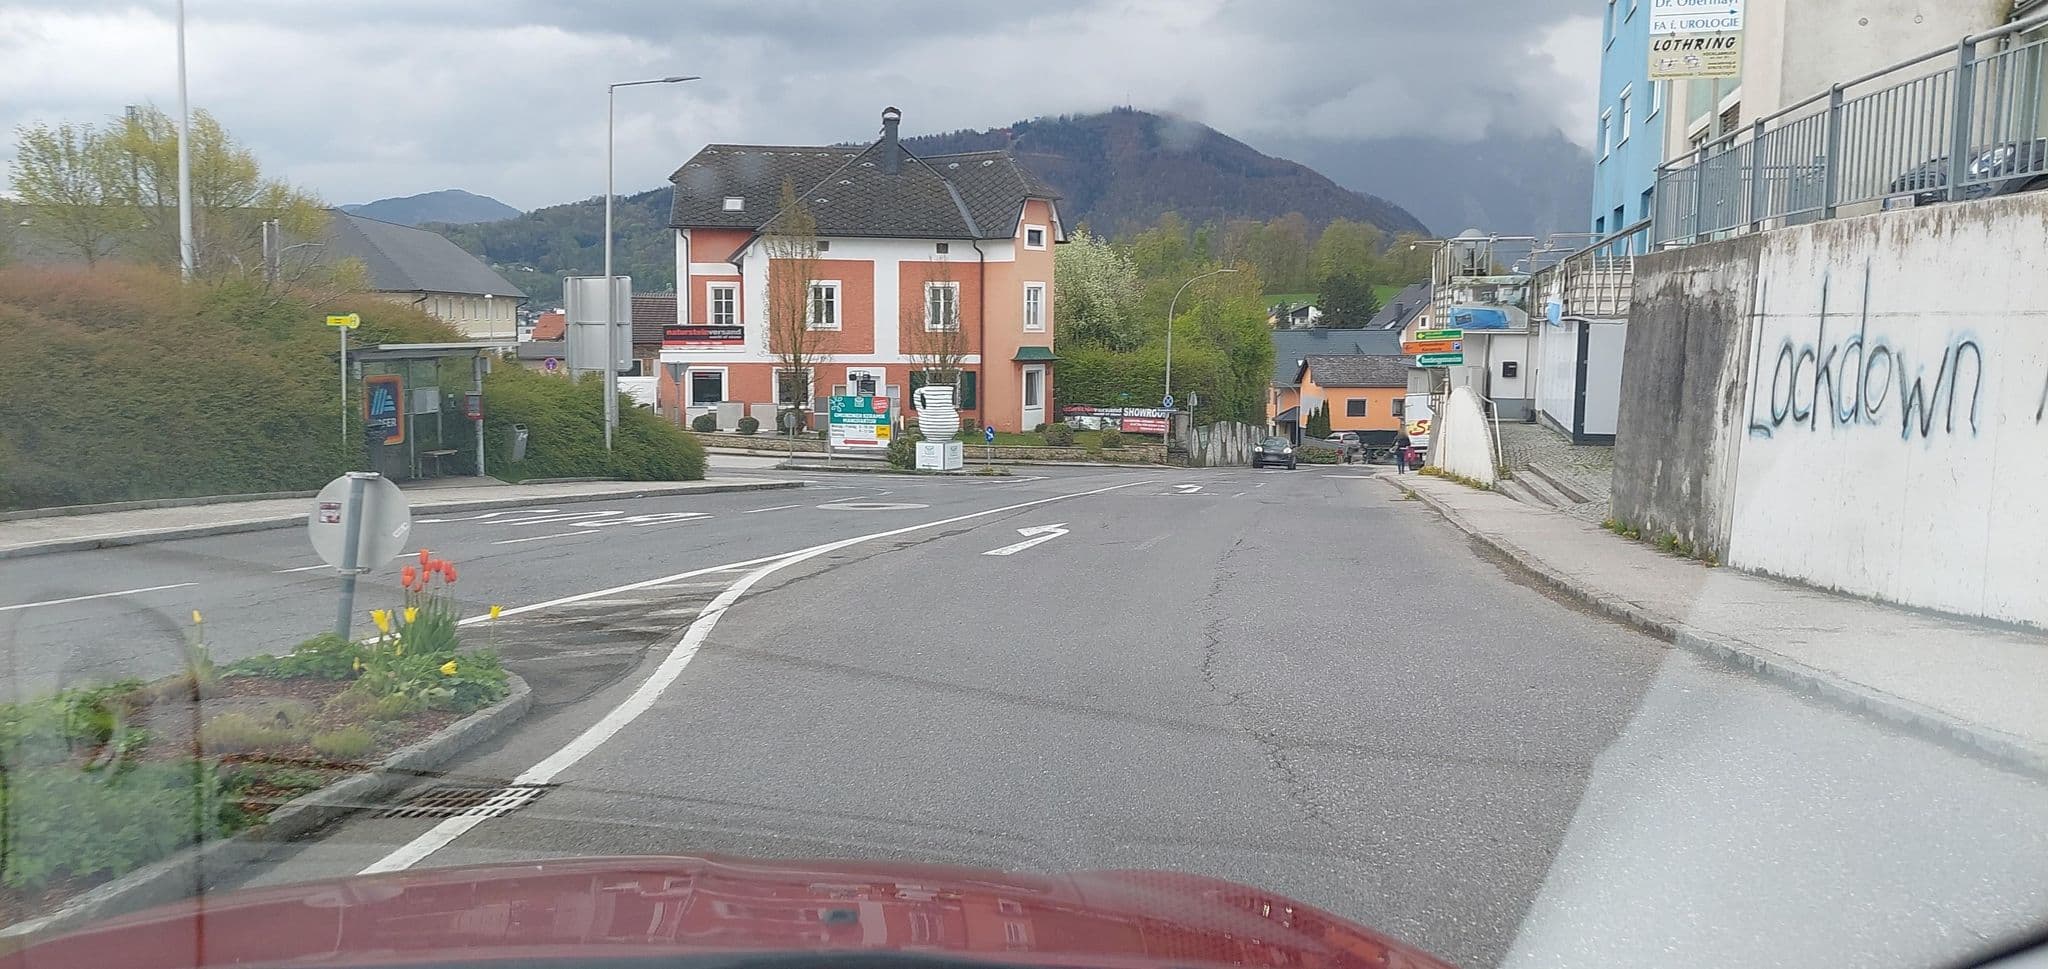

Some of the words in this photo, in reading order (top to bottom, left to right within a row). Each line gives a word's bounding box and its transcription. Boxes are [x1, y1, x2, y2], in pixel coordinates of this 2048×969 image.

[1655, 0, 1672, 8] Dr.
[1654, 21, 1666, 30] FA
[1680, 18, 1739, 30] UROLOGIE
[1653, 37, 1736, 51] LOTHRING
[1749, 257, 1983, 440] Lockdown
